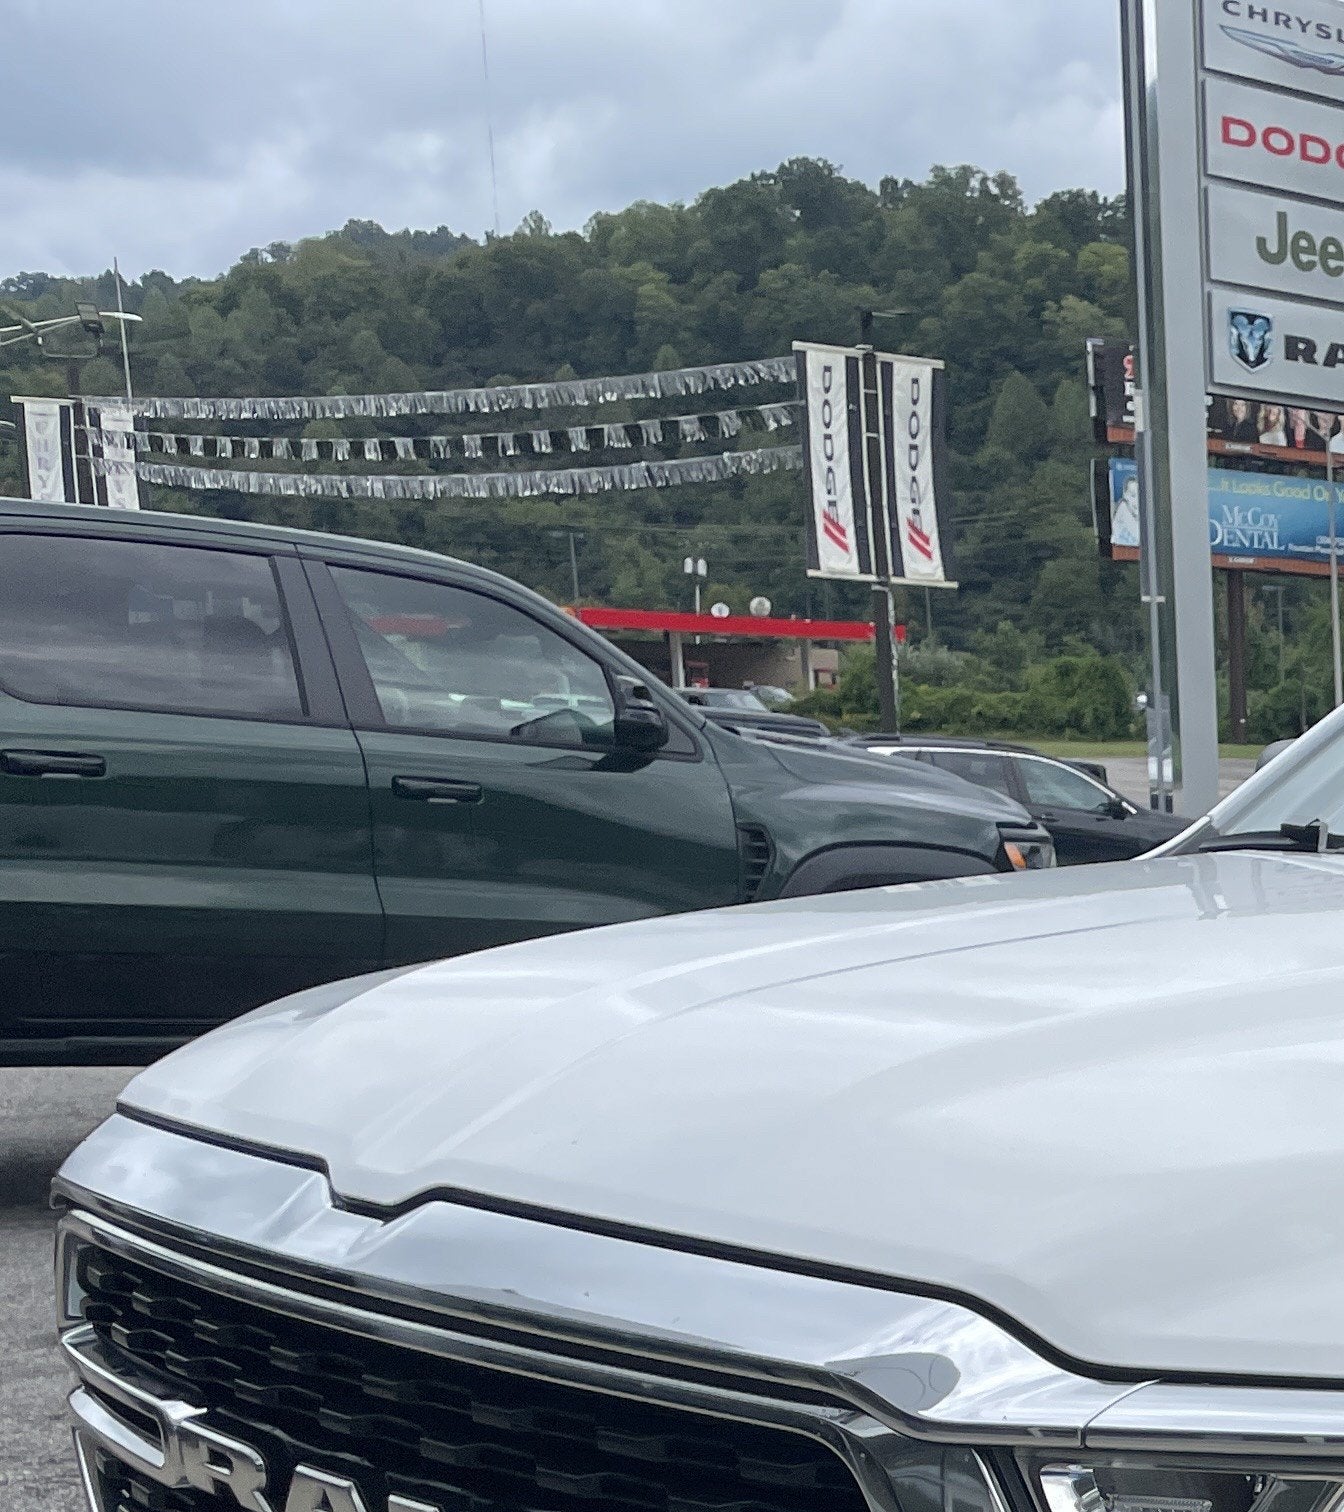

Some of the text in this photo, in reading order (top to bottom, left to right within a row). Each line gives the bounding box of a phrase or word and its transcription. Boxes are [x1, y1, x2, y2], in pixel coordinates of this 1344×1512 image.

[823, 366, 840, 524] DODGE
[1273, 480, 1311, 500] Good
[1208, 519, 1286, 550] DENTAL
